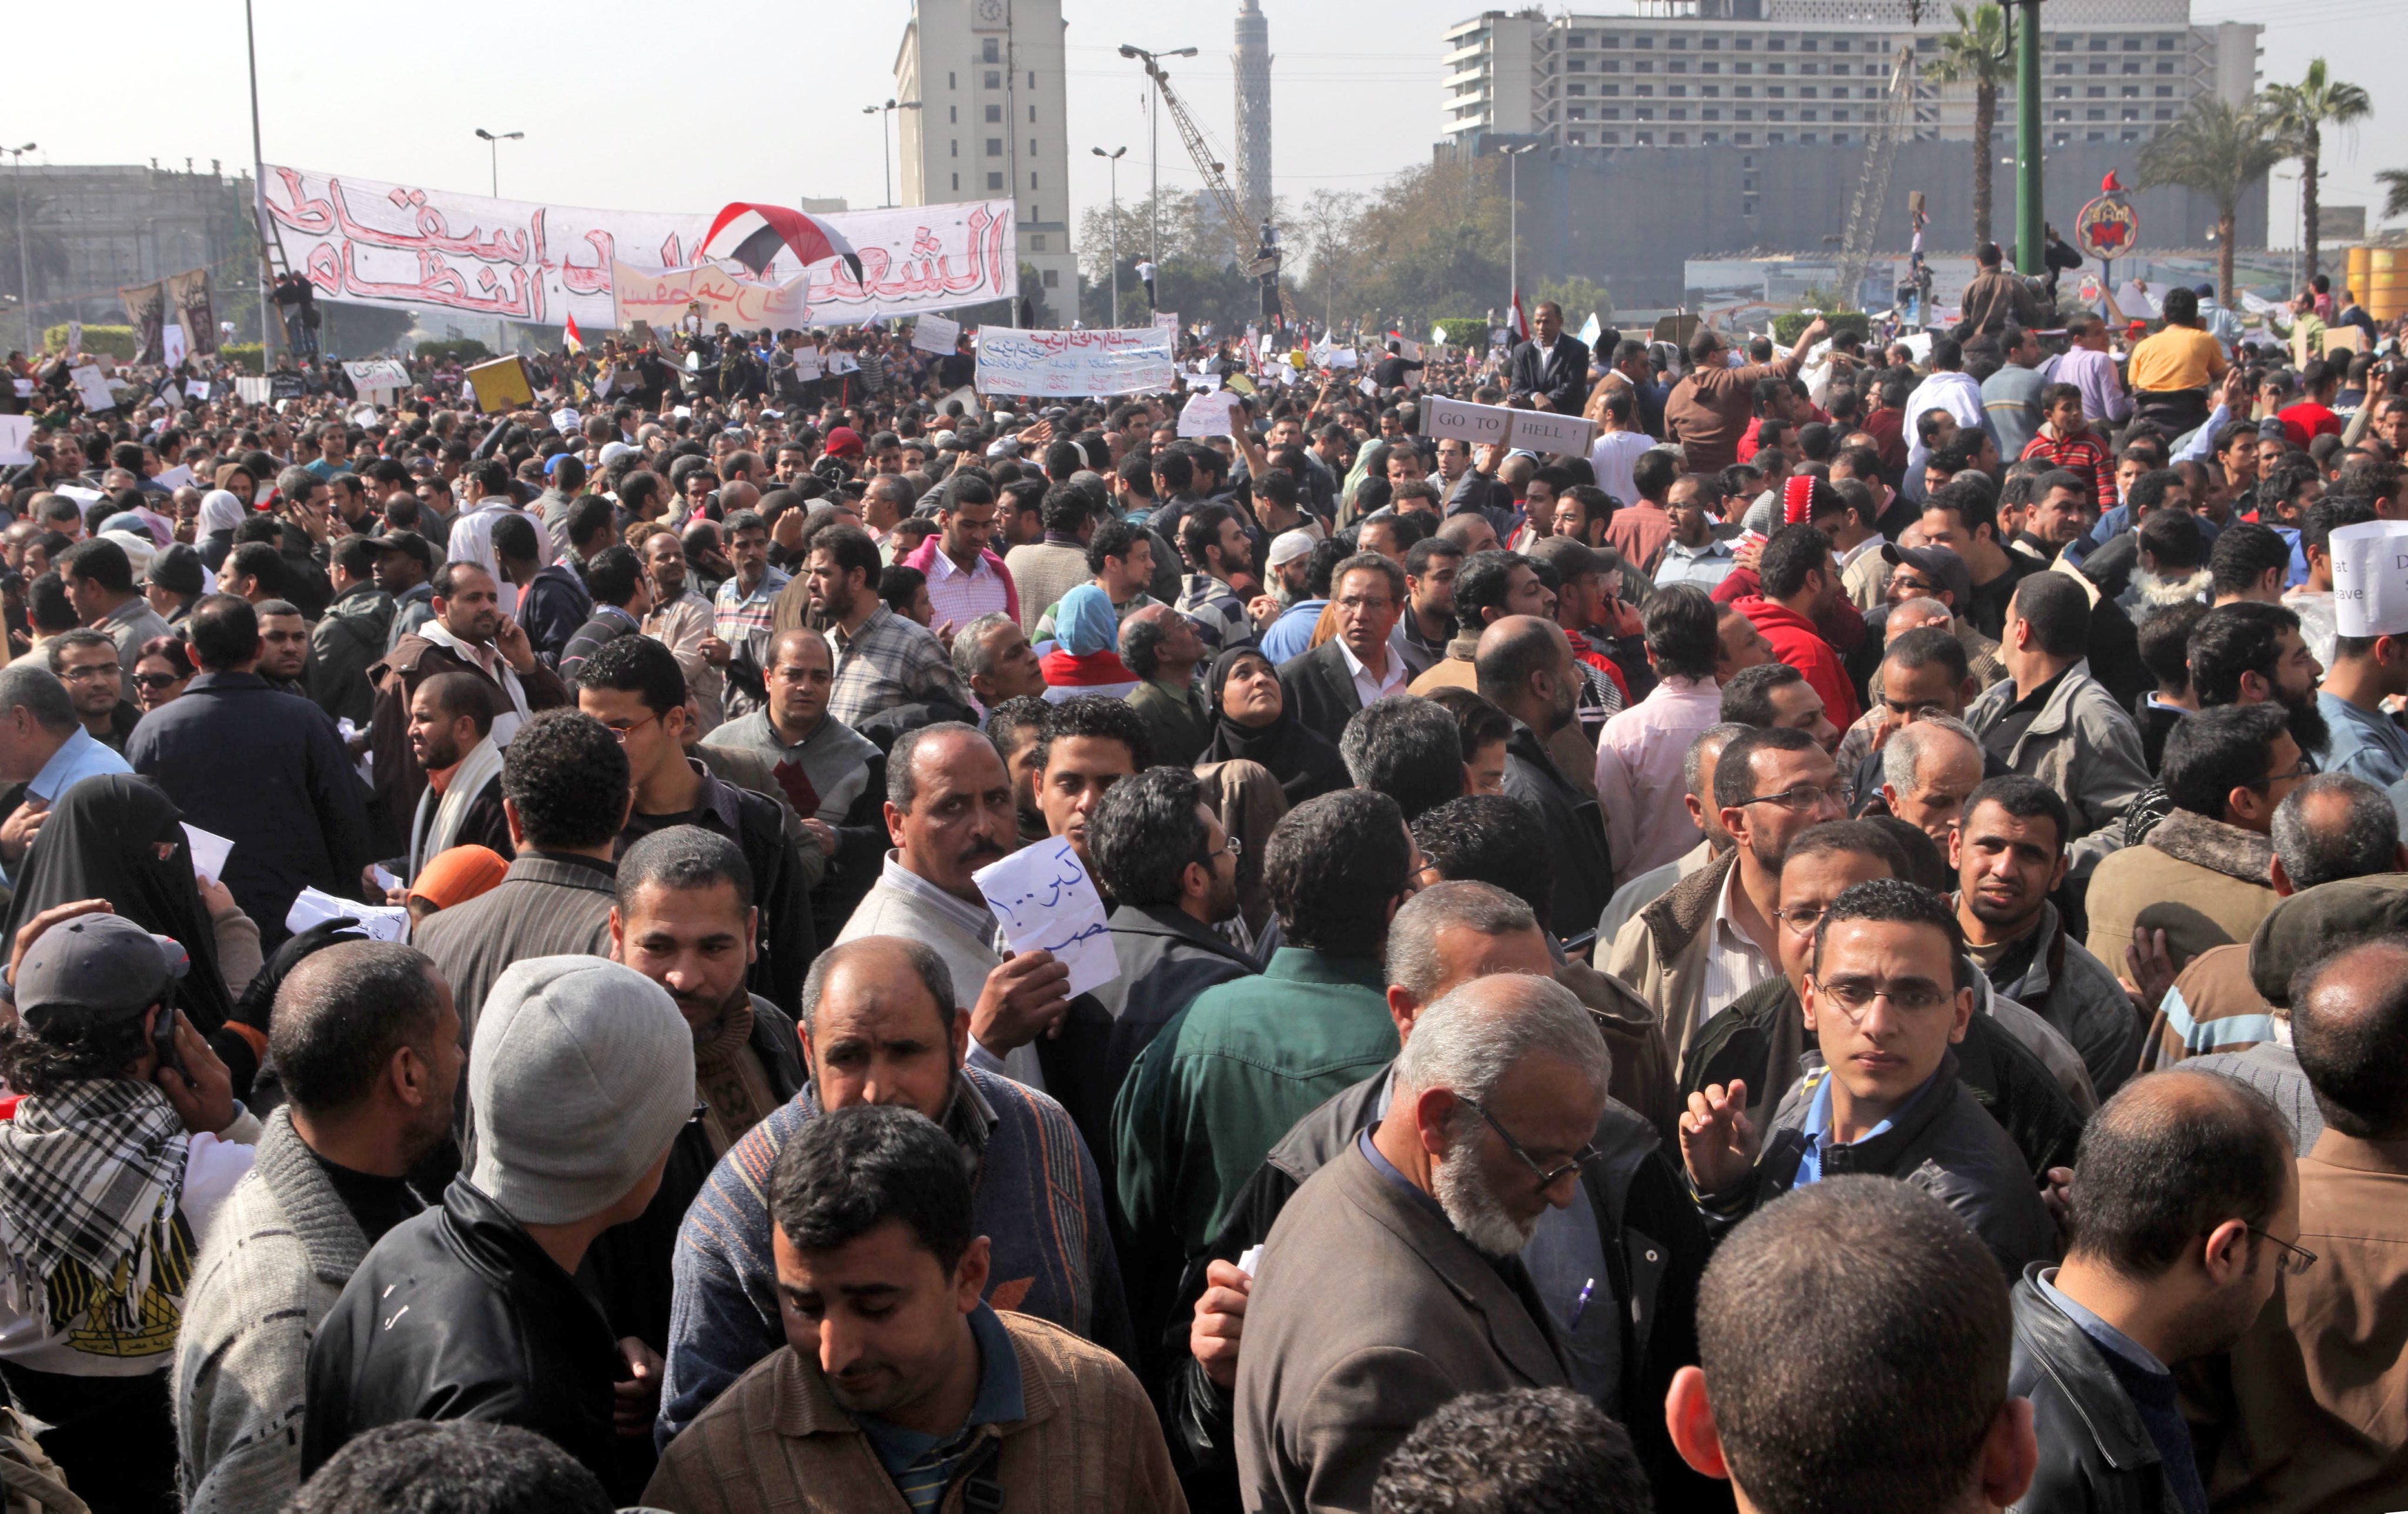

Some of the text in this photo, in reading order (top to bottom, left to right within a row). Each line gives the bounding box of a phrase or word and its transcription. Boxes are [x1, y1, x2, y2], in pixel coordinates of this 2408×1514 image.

[264, 167, 557, 274] إسقاط
[2092, 222, 2125, 247] M
[303, 240, 546, 323] النظام
[1439, 413, 1577, 440] GO TO HELL !
[2333, 560, 2348, 573] at
